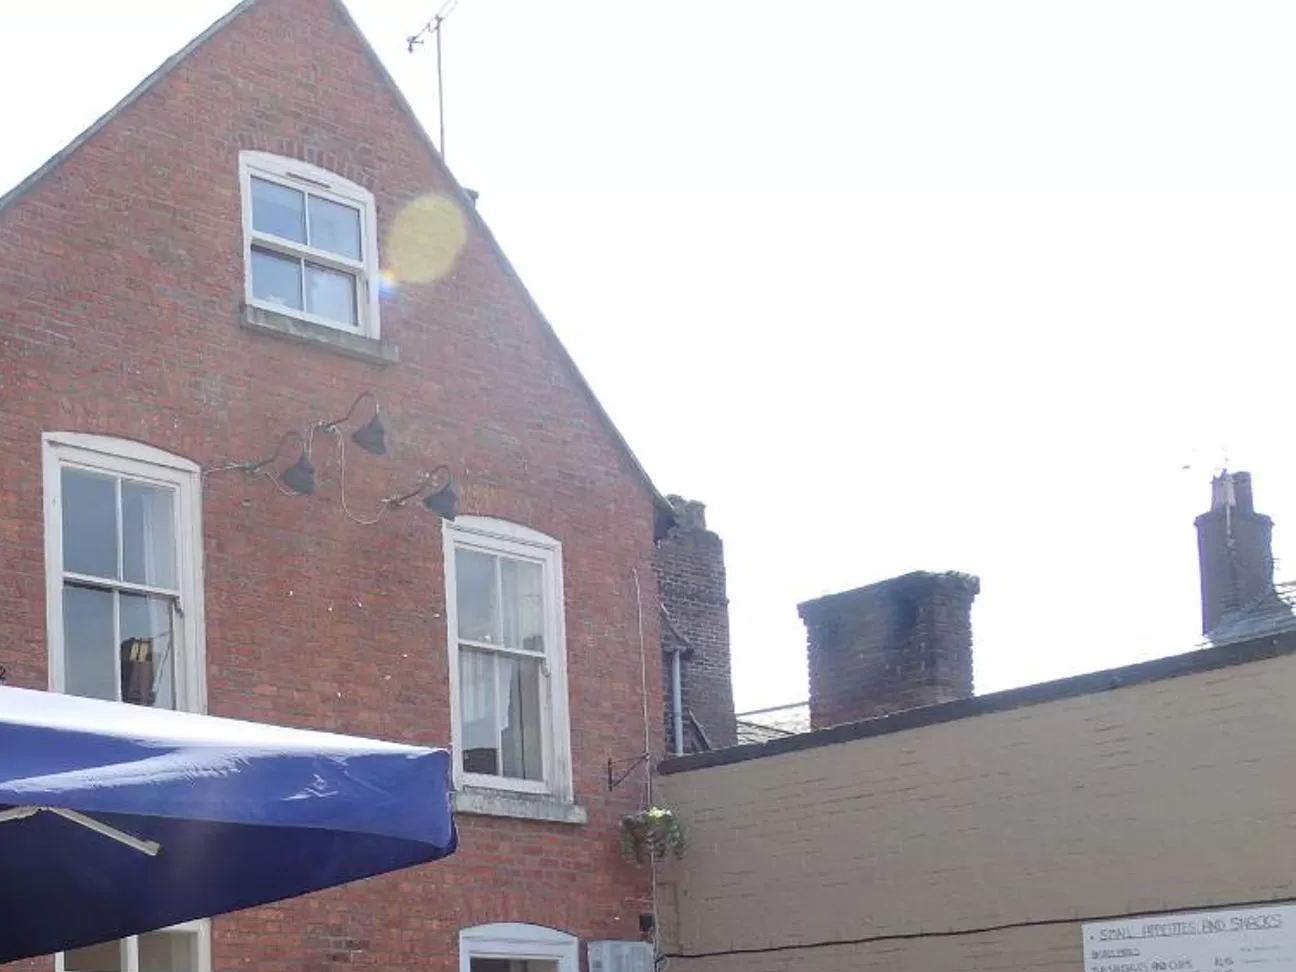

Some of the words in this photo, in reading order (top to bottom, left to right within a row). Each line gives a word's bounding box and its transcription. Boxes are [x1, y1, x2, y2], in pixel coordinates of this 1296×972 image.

[1099, 927, 1132, 939] SMALL
[1202, 919, 1226, 932] AND
[1230, 913, 1283, 930] SNACKS
